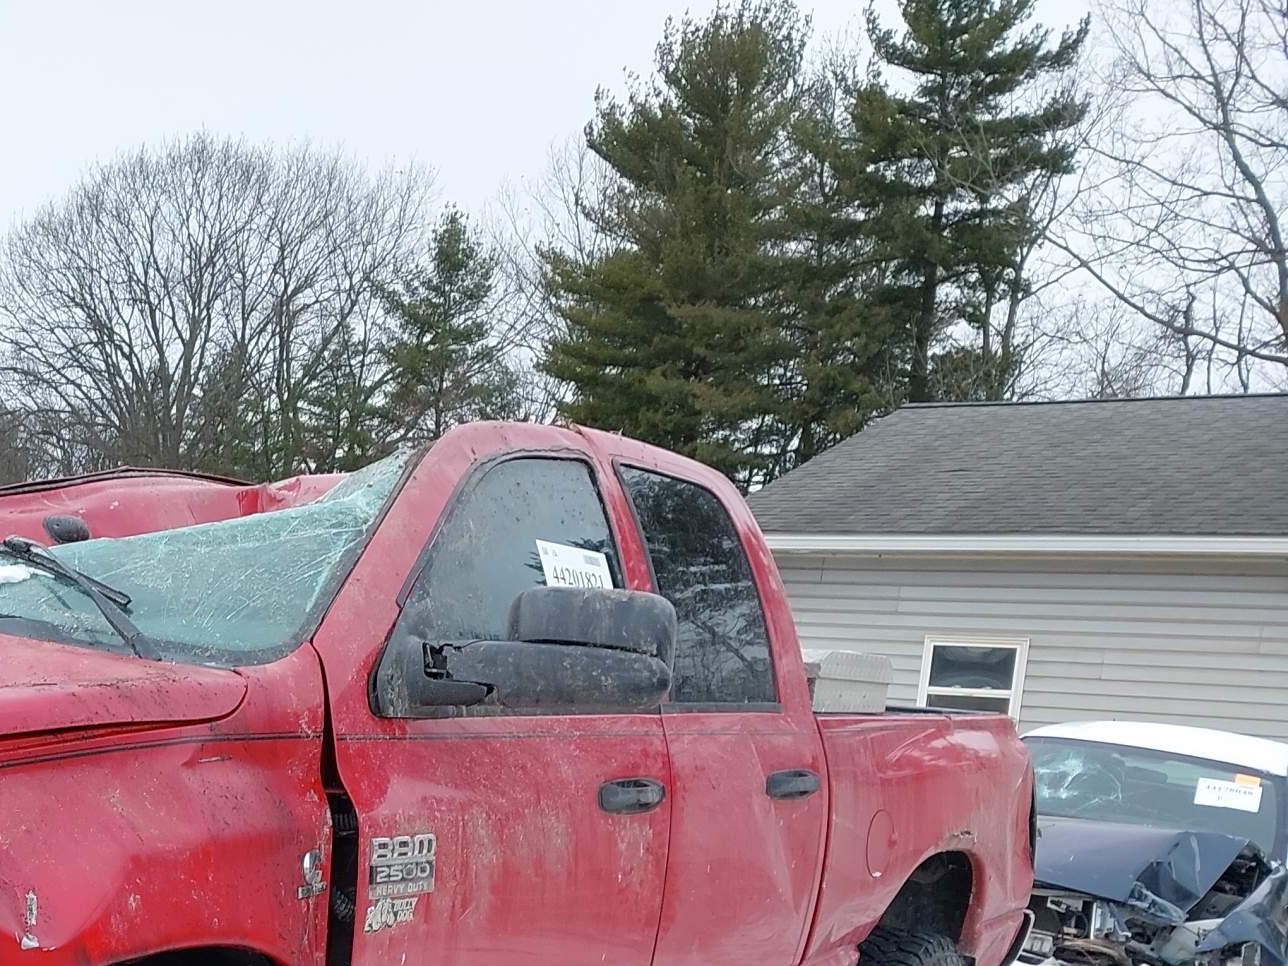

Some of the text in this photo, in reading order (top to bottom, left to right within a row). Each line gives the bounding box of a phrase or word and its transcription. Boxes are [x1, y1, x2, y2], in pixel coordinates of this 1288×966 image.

[552, 565, 604, 590] 44201821
[371, 833, 437, 865] RAM
[375, 863, 431, 883] 2500
[376, 881, 429, 897] HEAVY DUTY
